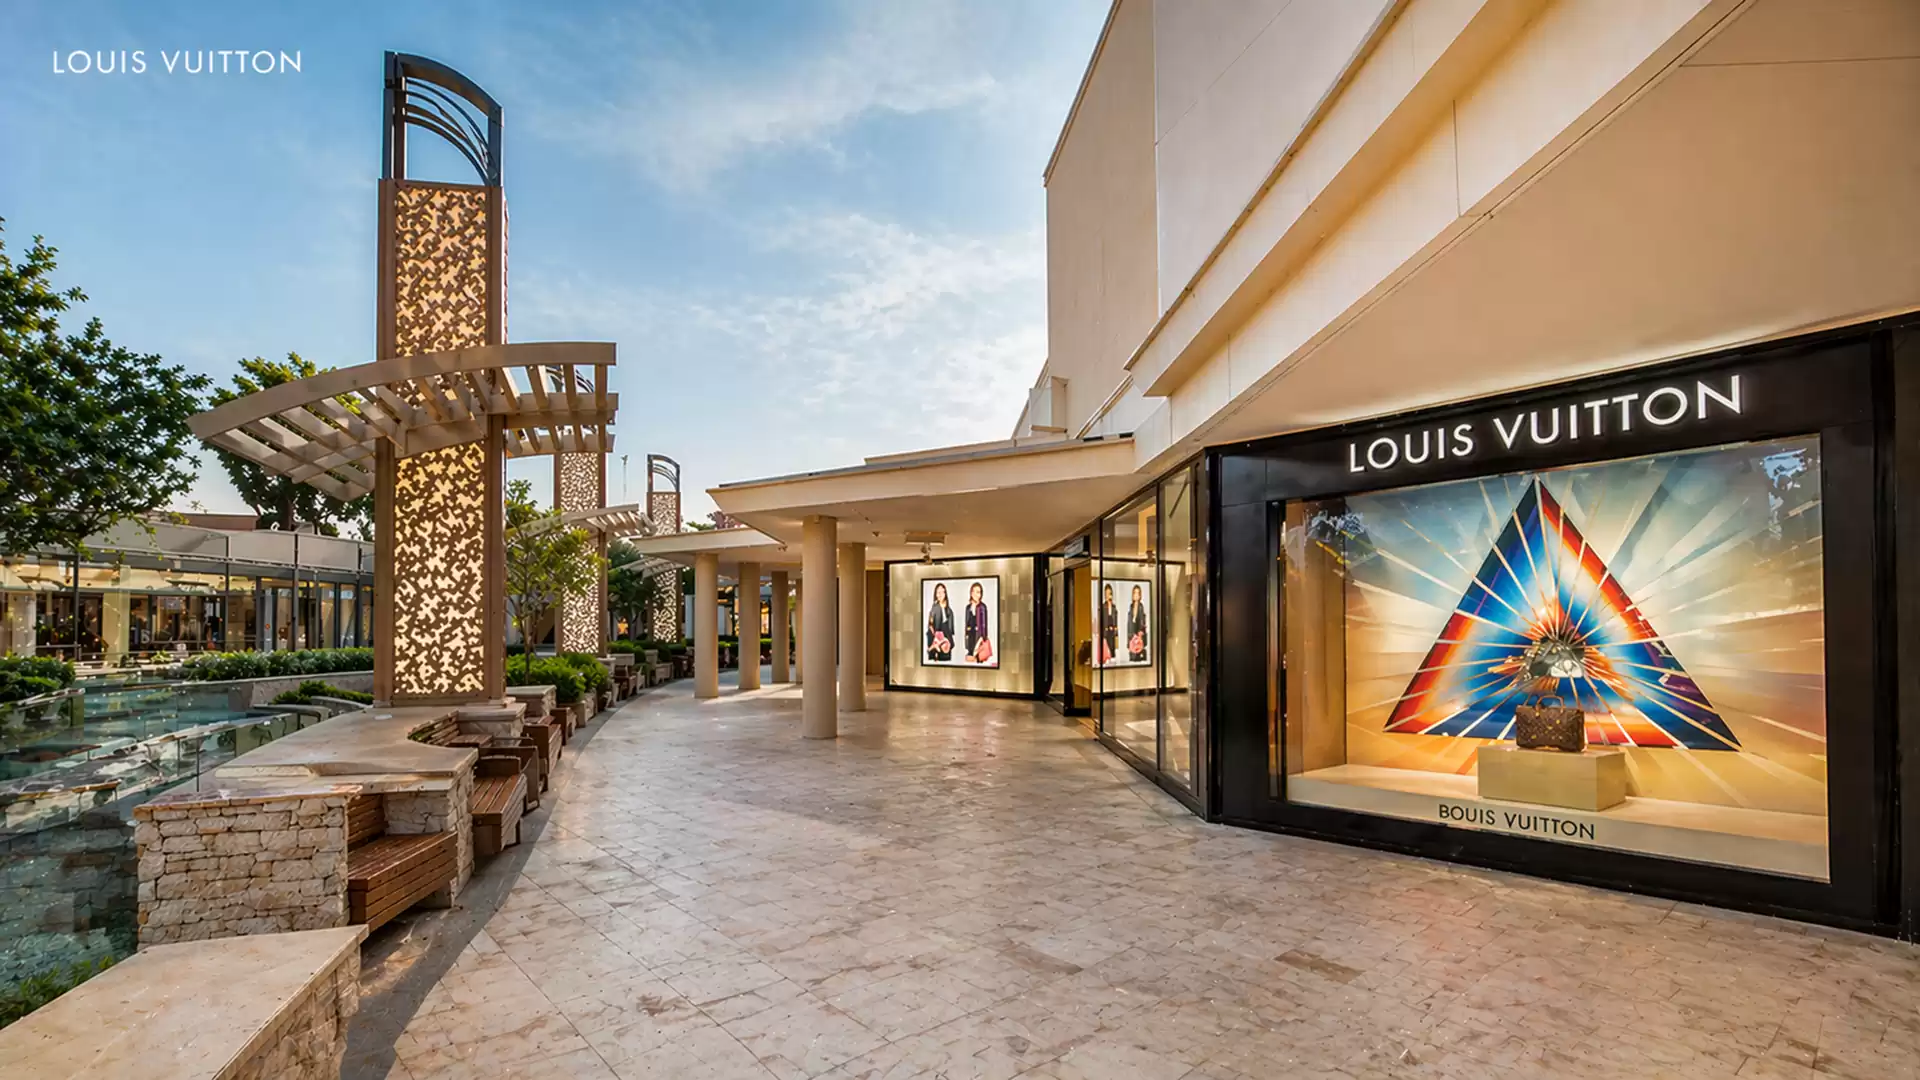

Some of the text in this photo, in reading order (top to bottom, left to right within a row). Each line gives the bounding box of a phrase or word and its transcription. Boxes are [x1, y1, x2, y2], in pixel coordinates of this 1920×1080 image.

[1349, 374, 1742, 473] LOUIS VUITTON
[1438, 803, 1595, 841] BOUIS VUITTON
